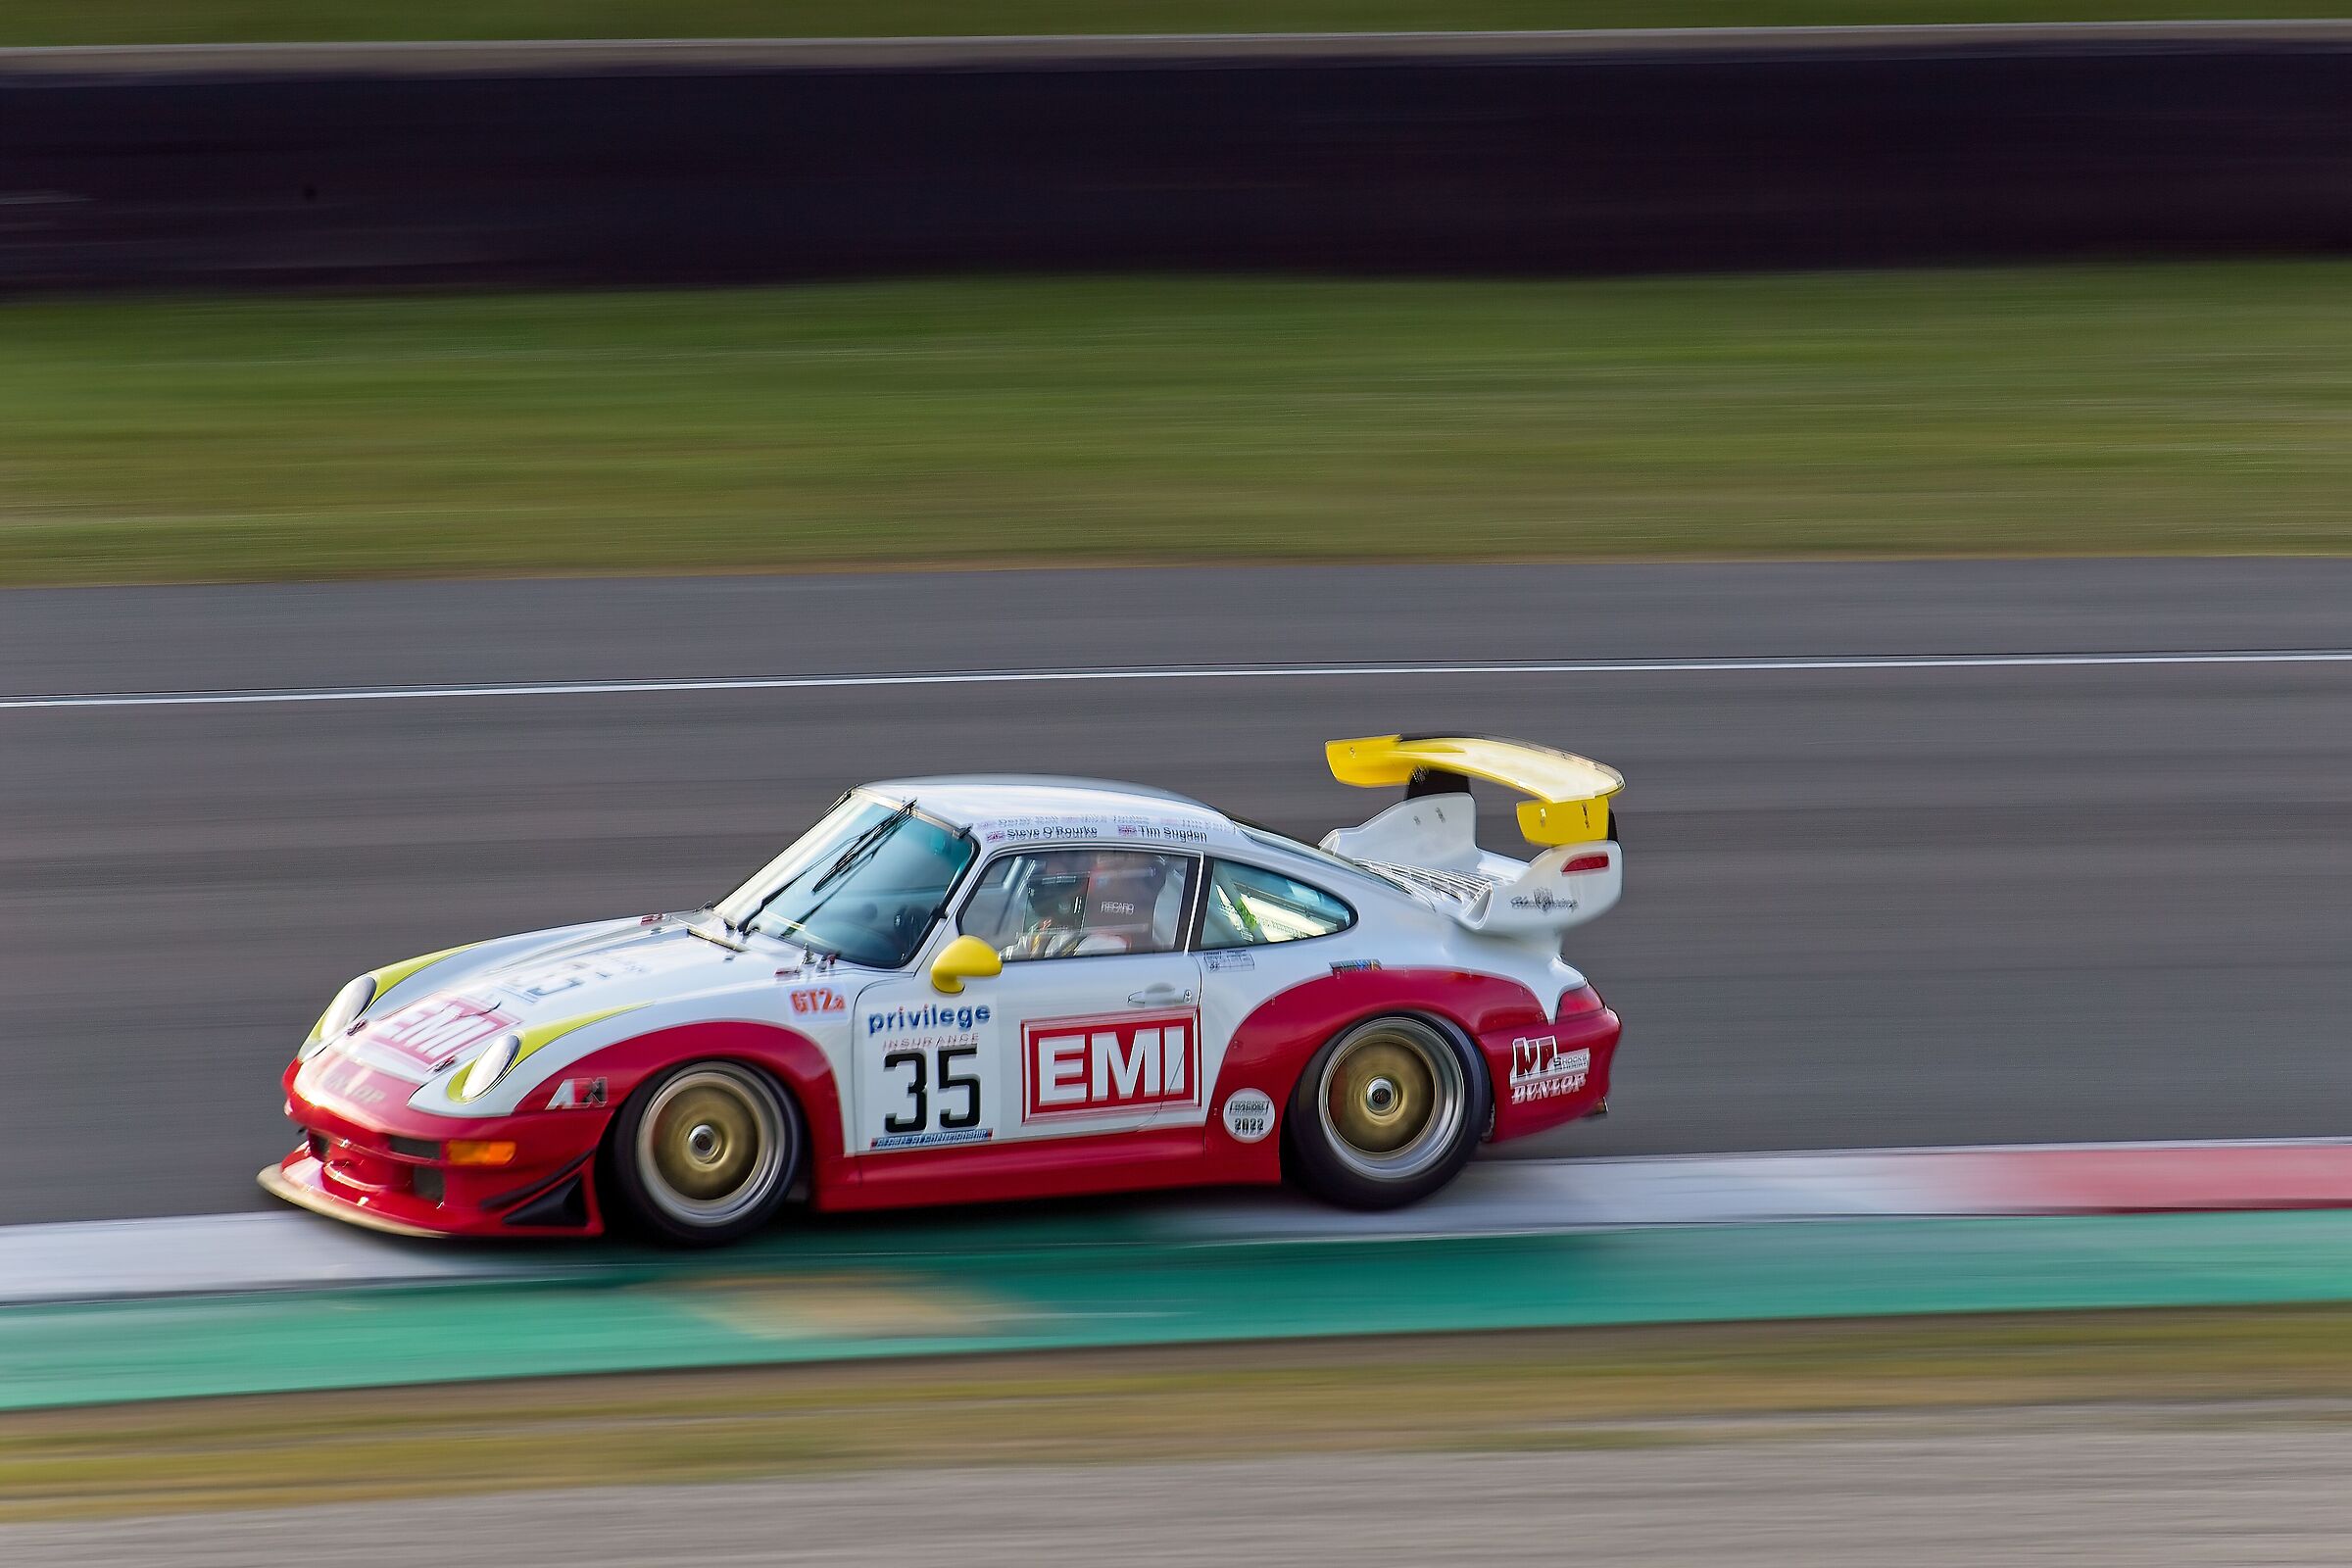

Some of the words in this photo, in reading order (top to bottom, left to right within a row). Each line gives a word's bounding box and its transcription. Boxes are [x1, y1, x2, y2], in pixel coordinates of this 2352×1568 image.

[1006, 827, 1040, 841] Steve
[1043, 825, 1098, 840] O'Rourke
[1139, 825, 1160, 839] Tim
[1163, 826, 1207, 843] Sugden
[1101, 901, 1135, 914] RECARO
[868, 1004, 991, 1037] privilege
[883, 1033, 980, 1052] INSURANCE
[1038, 1025, 1185, 1106] EMI
[884, 1045, 981, 1134] 35
[1511, 1074, 1587, 1104] DUNLOP
[1235, 1117, 1264, 1133] 2022
